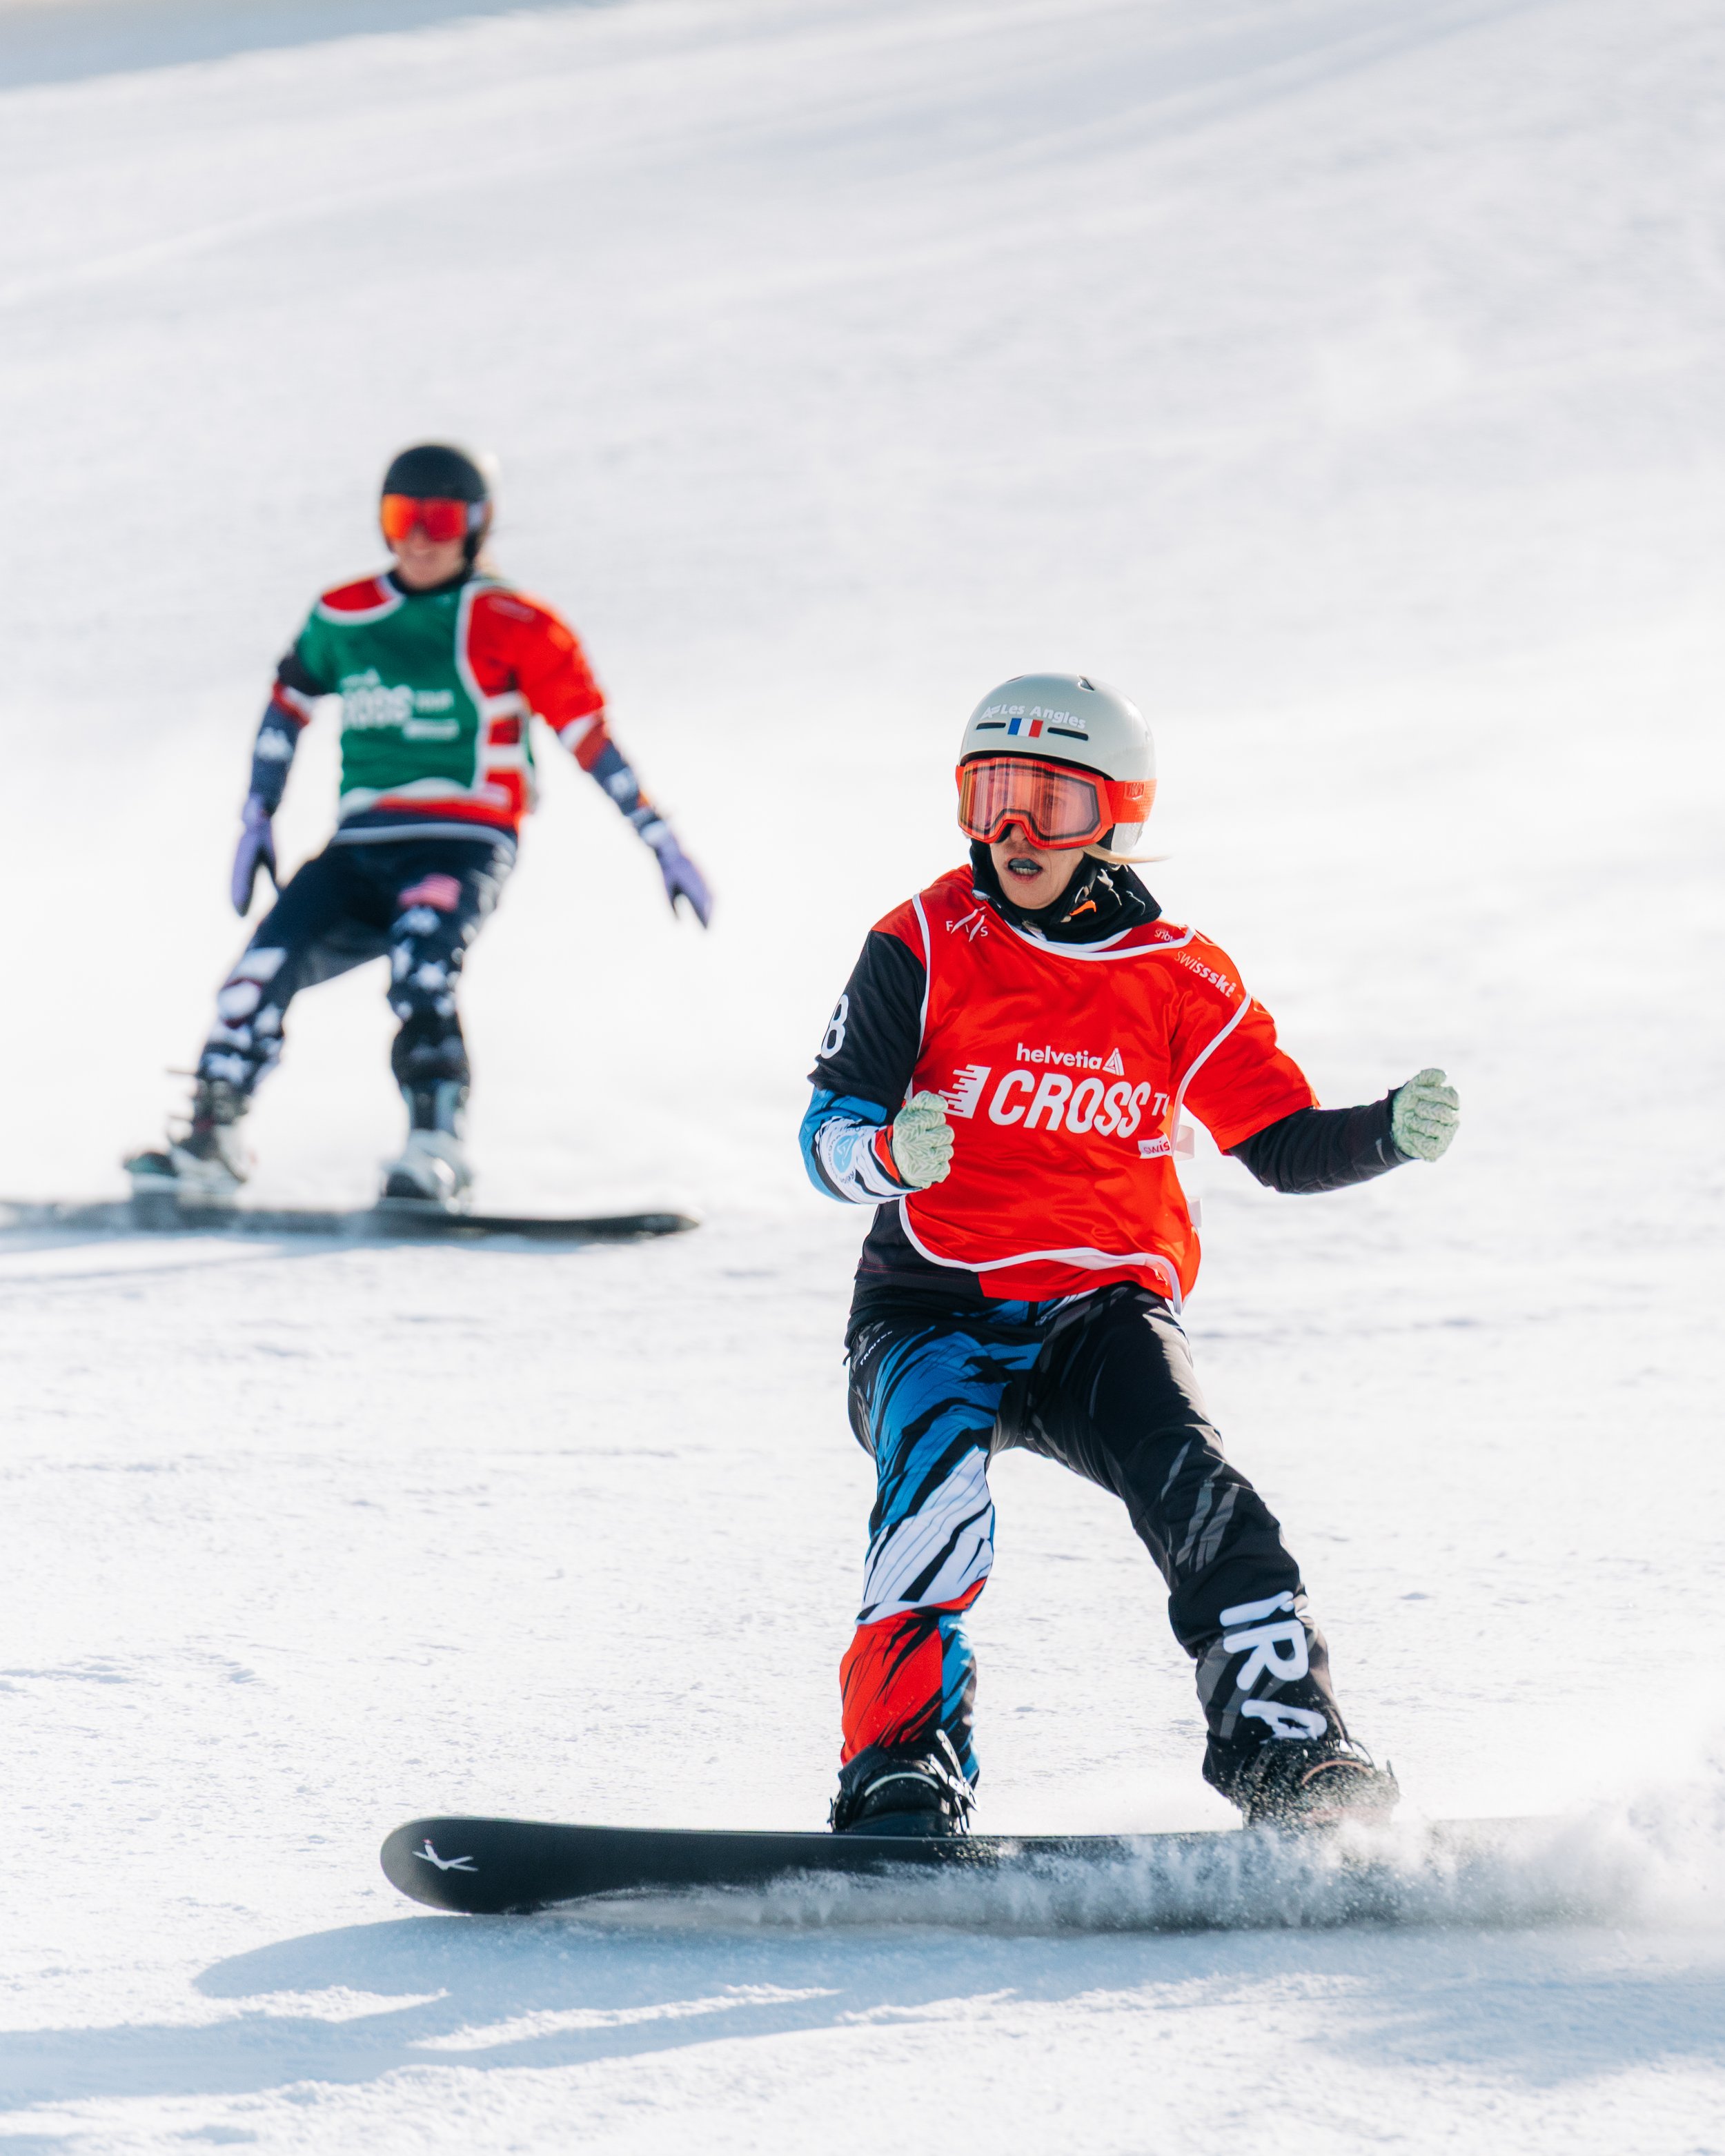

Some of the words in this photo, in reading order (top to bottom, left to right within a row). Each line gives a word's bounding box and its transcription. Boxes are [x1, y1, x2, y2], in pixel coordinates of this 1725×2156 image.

[1000, 704, 1025, 715] Les
[1029, 706, 1087, 729] Angles
[1174, 950, 1237, 998] swissski
[820, 993, 849, 1059] 8
[1016, 1042, 1102, 1070] helvetia
[988, 1069, 1152, 1138] CROSS
